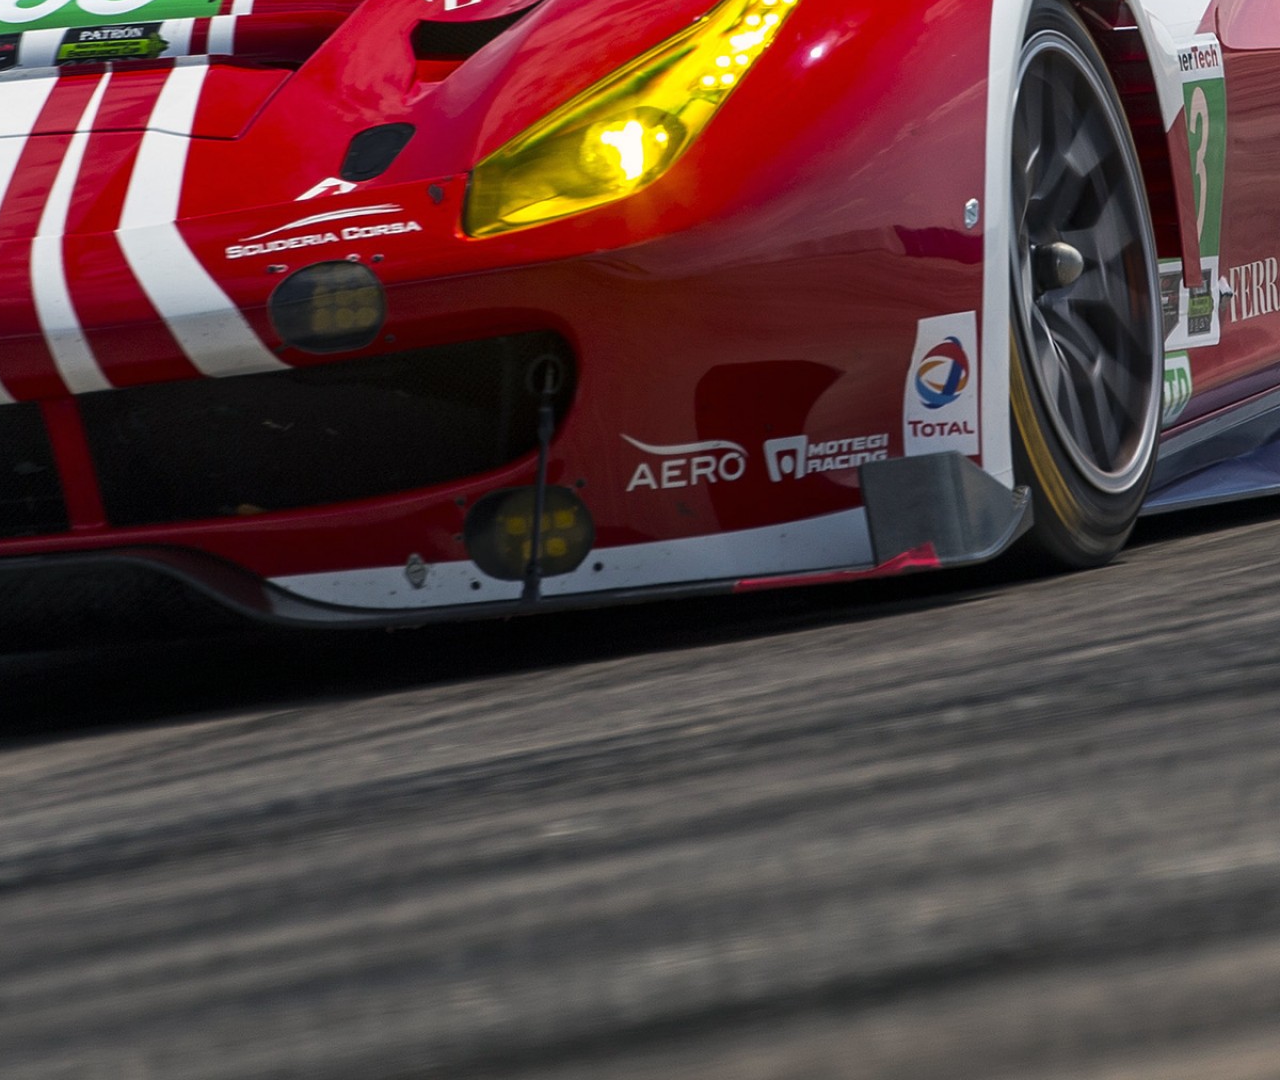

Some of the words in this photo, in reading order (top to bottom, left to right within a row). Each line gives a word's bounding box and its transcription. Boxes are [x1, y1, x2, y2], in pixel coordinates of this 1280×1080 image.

[225, 232, 340, 259] SCUDERIA
[341, 221, 423, 240] CORSA
[907, 420, 975, 438] TOTAL
[807, 433, 889, 457] MOTEGI
[625, 452, 746, 493] AERO
[806, 449, 888, 473] RACING
